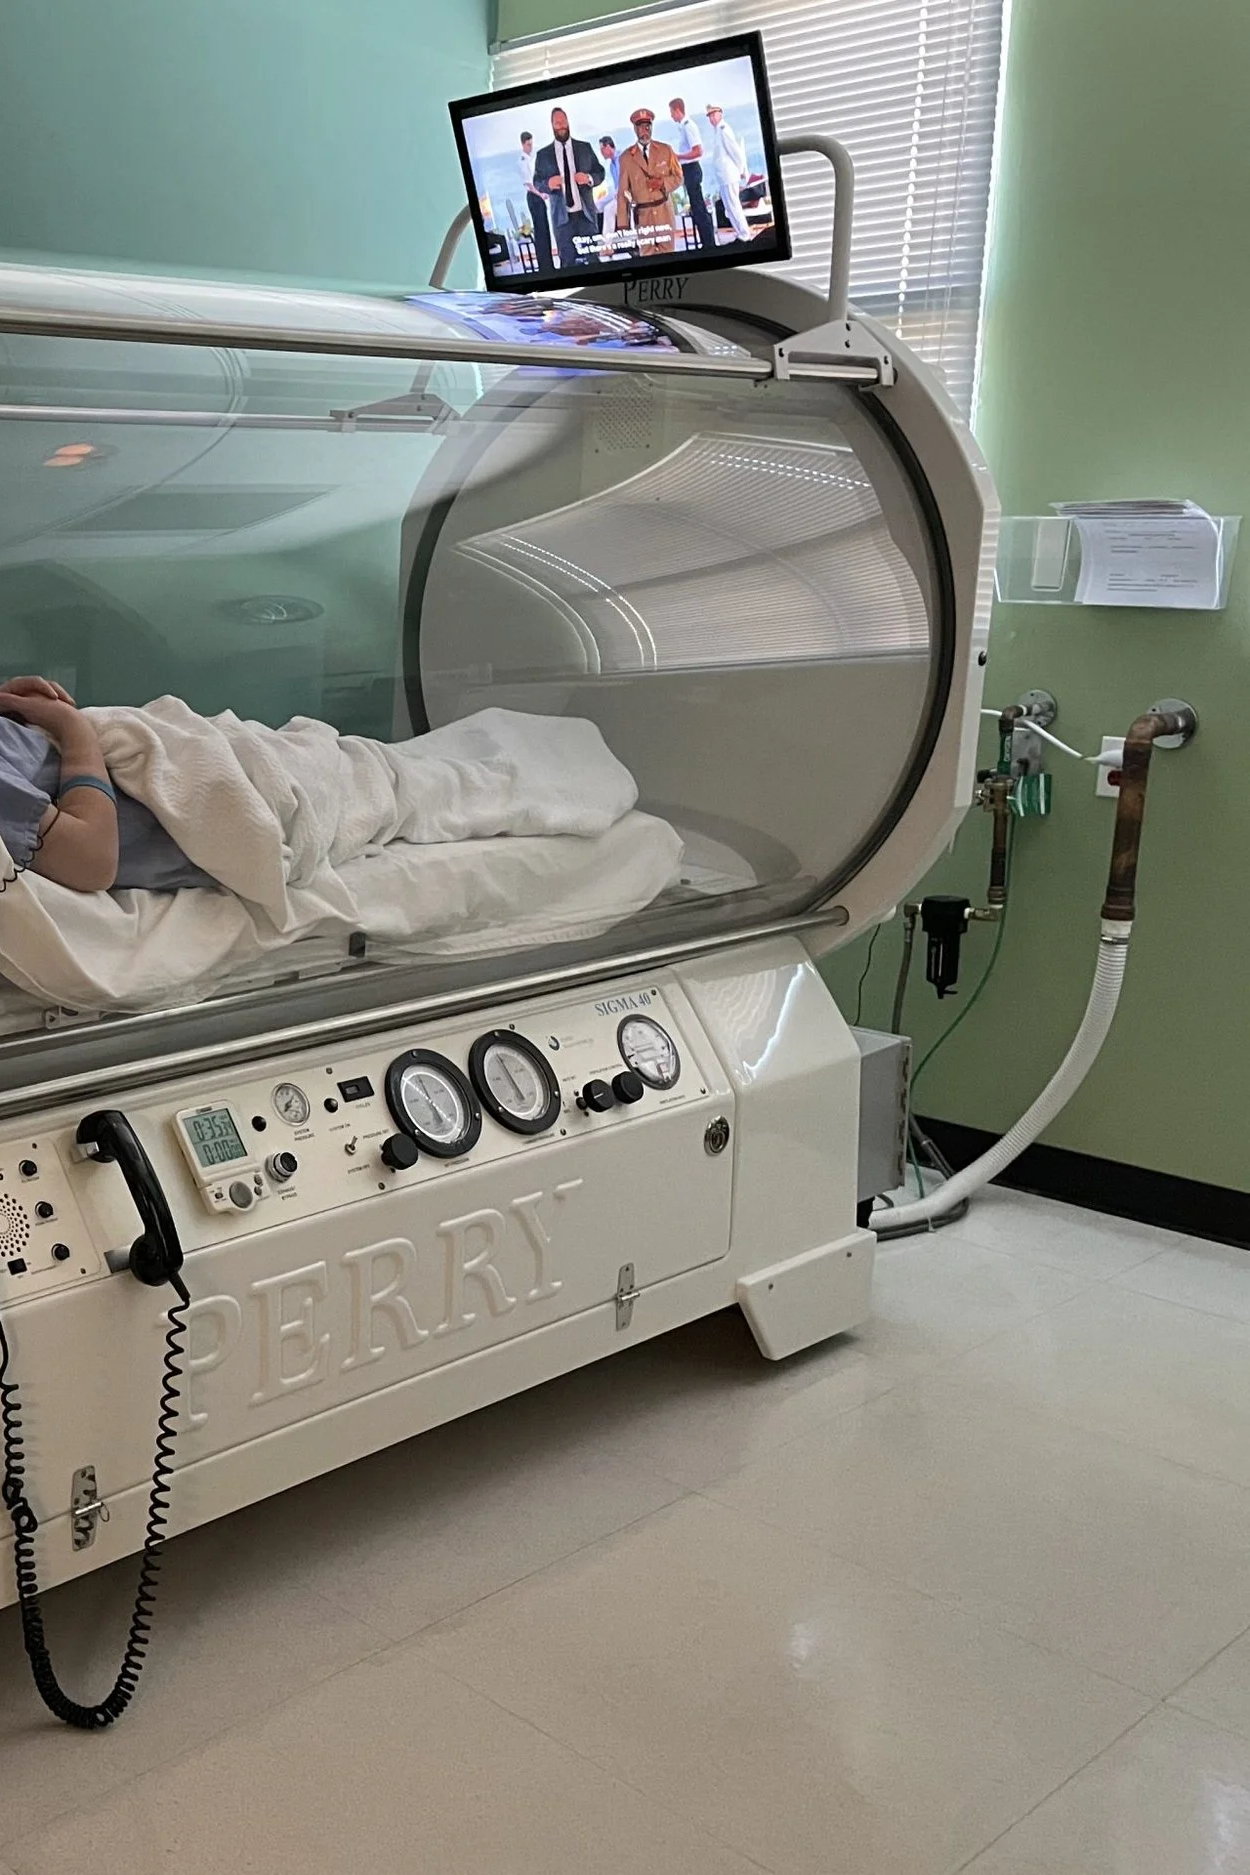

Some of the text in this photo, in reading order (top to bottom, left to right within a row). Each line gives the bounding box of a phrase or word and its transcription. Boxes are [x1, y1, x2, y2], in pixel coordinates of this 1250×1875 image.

[617, 240, 636, 249] really
[637, 237, 655, 247] scary
[655, 235, 672, 243] man
[638, 225, 655, 236] right
[622, 277, 689, 305] PERRY
[595, 991, 652, 1017] SIGMA 40
[159, 1177, 586, 1436] PERRY
